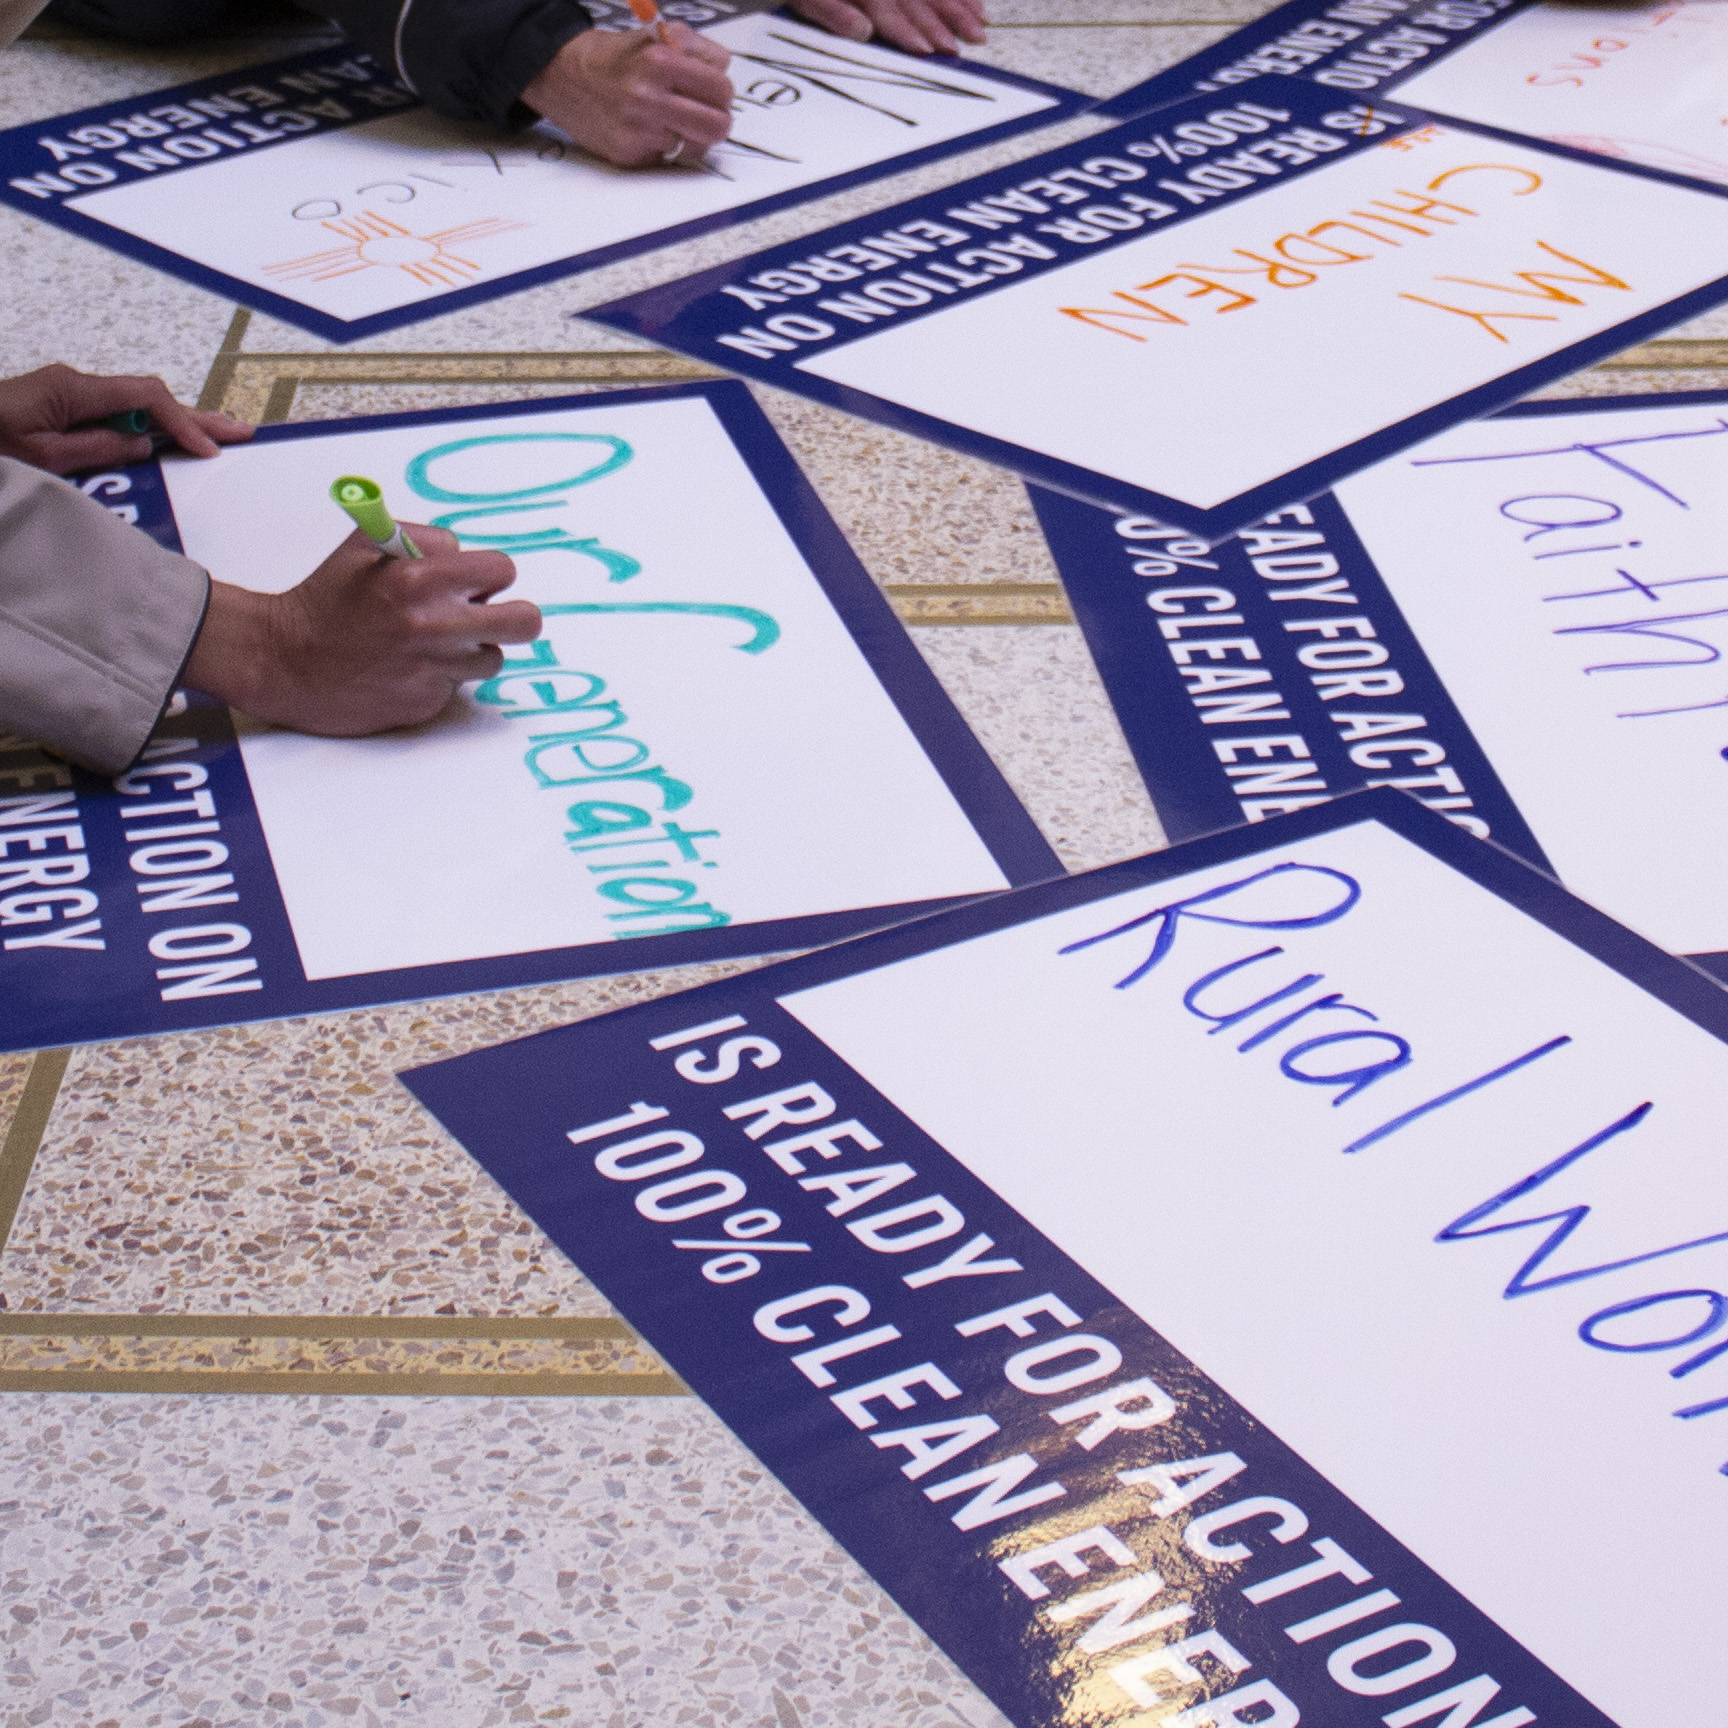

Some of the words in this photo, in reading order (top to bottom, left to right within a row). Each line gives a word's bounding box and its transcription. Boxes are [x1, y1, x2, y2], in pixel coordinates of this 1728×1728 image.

[728, 32, 996, 126] Ne
[1314, 25, 1450, 90] ACTIO
[37, 84, 286, 161] ENERGY
[115, 98, 352, 171] ACTION
[1126, 101, 1292, 165] 100%
[1158, 126, 1349, 205] READY
[9, 160, 118, 199] ON
[945, 155, 1148, 230] CLEAN
[1035, 192, 1179, 244] FOR
[719, 218, 971, 312] ENERGY
[817, 233, 1058, 324] ACTION
[1057, 162, 1544, 342] CHILDREN
[1398, 239, 1634, 344] MY
[715, 312, 836, 360] ON
[405, 431, 643, 584] Our
[1238, 504, 1359, 604] EADY
[1145, 585, 1292, 725] CLEAN
[1282, 615, 1405, 701] FOR
[147, 922, 264, 1002] ON
[1057, 860, 1573, 1155] Rural
[648, 1014, 782, 1085] IS
[721, 1080, 1025, 1290] READY
[954, 1291, 1176, 1452] FOR
[565, 1101, 813, 1285] 100%
[751, 1284, 1068, 1533] CLEAN
